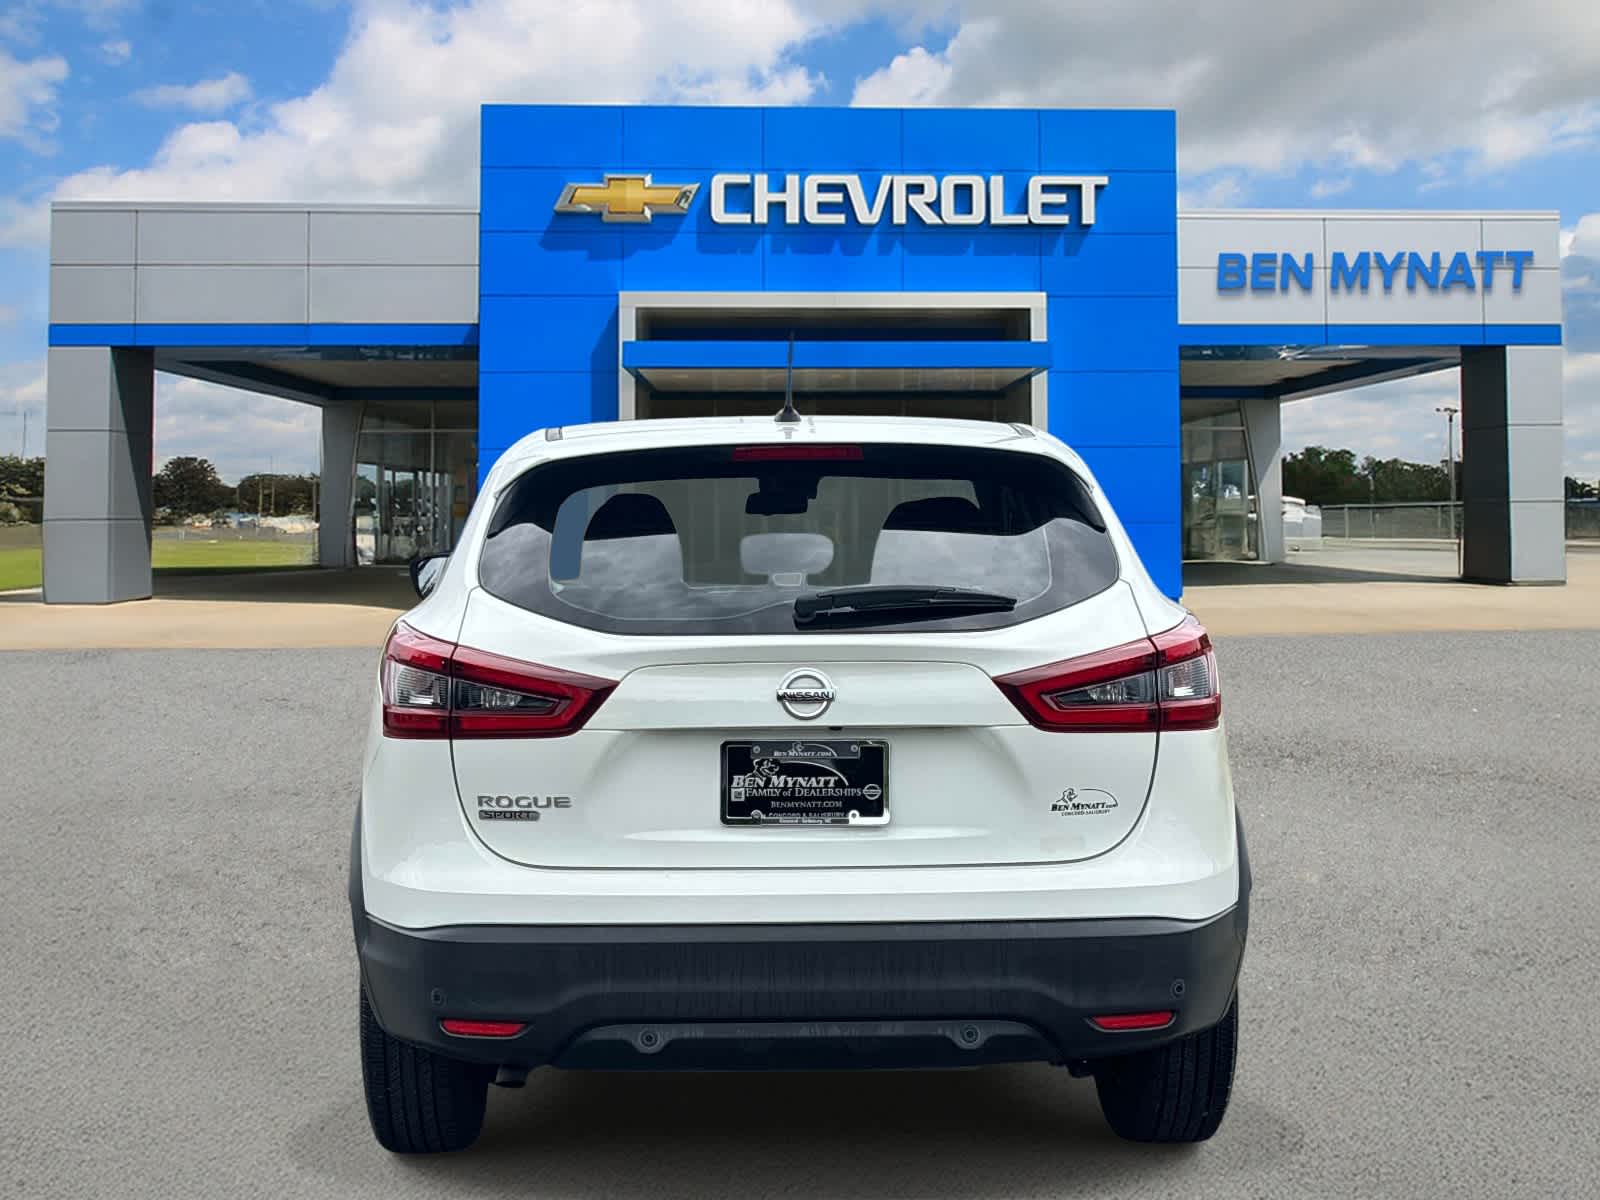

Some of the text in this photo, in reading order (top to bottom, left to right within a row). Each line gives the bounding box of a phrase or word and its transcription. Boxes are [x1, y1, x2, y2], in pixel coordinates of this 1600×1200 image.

[710, 174, 1109, 225] CHEVROLET
[1217, 250, 1534, 290] BEN MYNATT
[783, 691, 830, 699] NISSAN
[732, 775, 838, 788] BEN MYNATT
[746, 788, 780, 797] FAMILY
[782, 789, 791, 797] of
[795, 787, 862, 797] DEALERSHIPS
[477, 796, 573, 809] ROGUE
[1051, 803, 1070, 811] BEN
